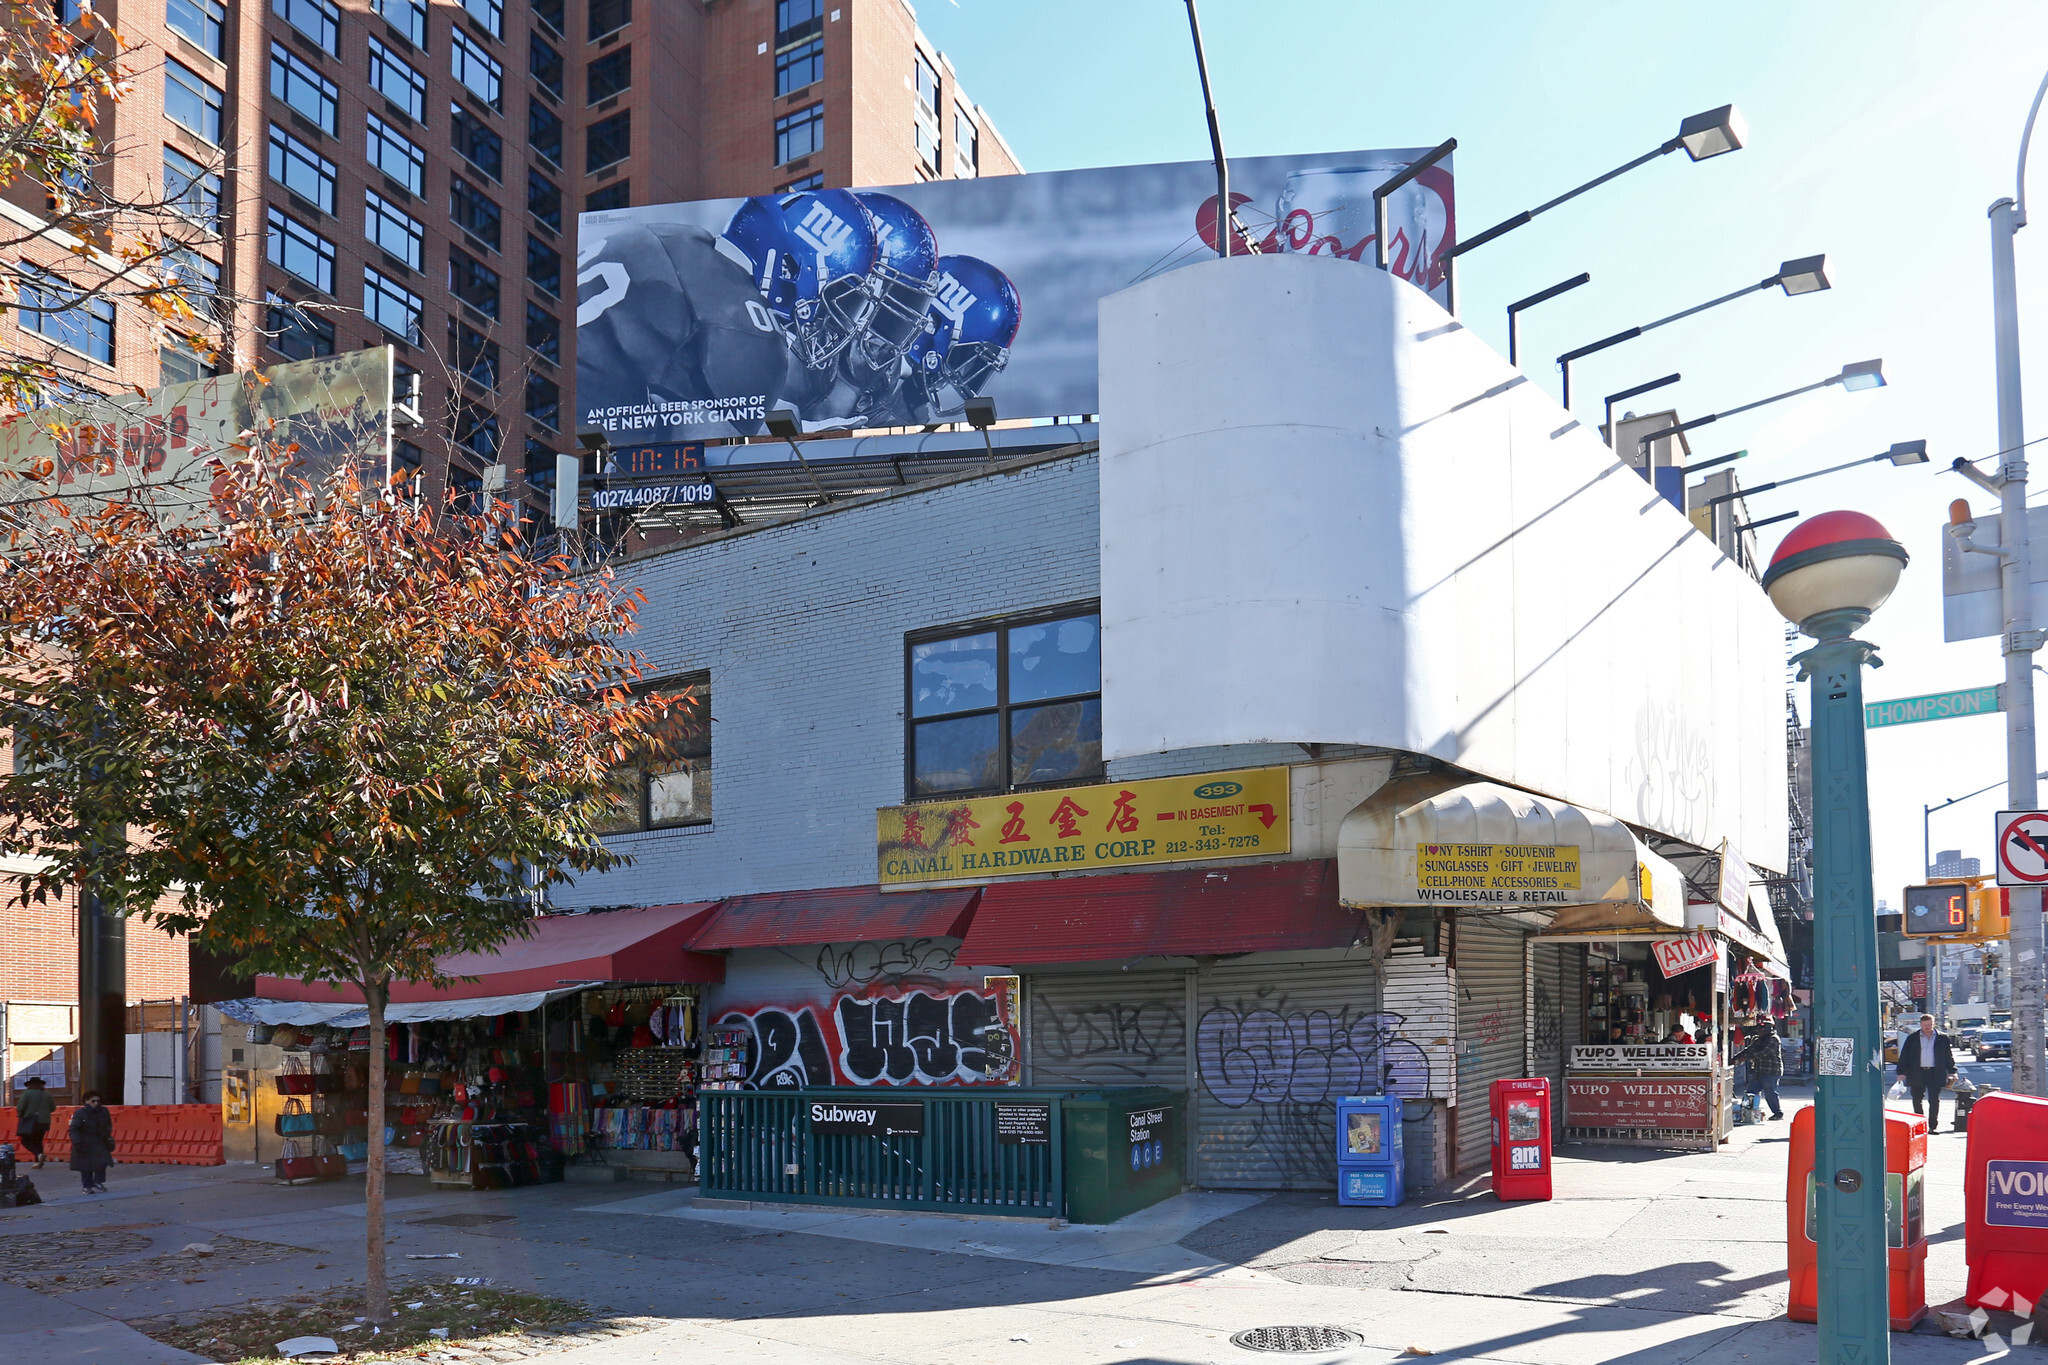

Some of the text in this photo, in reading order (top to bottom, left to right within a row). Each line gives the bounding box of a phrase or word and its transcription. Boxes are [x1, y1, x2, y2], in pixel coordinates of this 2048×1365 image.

[587, 395, 766, 419] AN OFFICIAL BEER SPONSOR OF
[621, 415, 656, 431] NEW
[659, 411, 705, 427] YORK
[707, 406, 767, 423] GIANTS
[1867, 689, 1998, 726] THOMPSON ST
[1199, 782, 1240, 798] 393
[1178, 804, 1246, 821] IN BASEMENT
[1199, 824, 1227, 837] Tel:
[886, 838, 1157, 877] CANAL HARDWARE CORP.
[1456, 846, 1493, 857] T-SHIRT
[1504, 846, 1556, 858] SOUVENIR
[1425, 861, 1577, 873] SUNGLASSES GIFT JEWELRY
[1425, 876, 1487, 887] CELL-PHONE
[1491, 876, 1558, 888] ACCESSORIES
[1417, 889, 1568, 902] WHOLESALE & RETAIL
[1949, 895, 1965, 925] 6
[1663, 932, 1711, 968] ATM
[1574, 1047, 1708, 1058] YUPO WELLNESS
[1569, 1084, 1707, 1095] YUPO WELLNESS
[811, 1104, 877, 1126] Subway
[1130, 1111, 1163, 1128] Canal Street
[1130, 1128, 1150, 1143] Station
[1133, 1146, 1160, 1165] A C E
[1995, 1171, 2048, 1197] VOI
[1996, 1201, 2012, 1209] Free
[2013, 1202, 2034, 1211] Every
